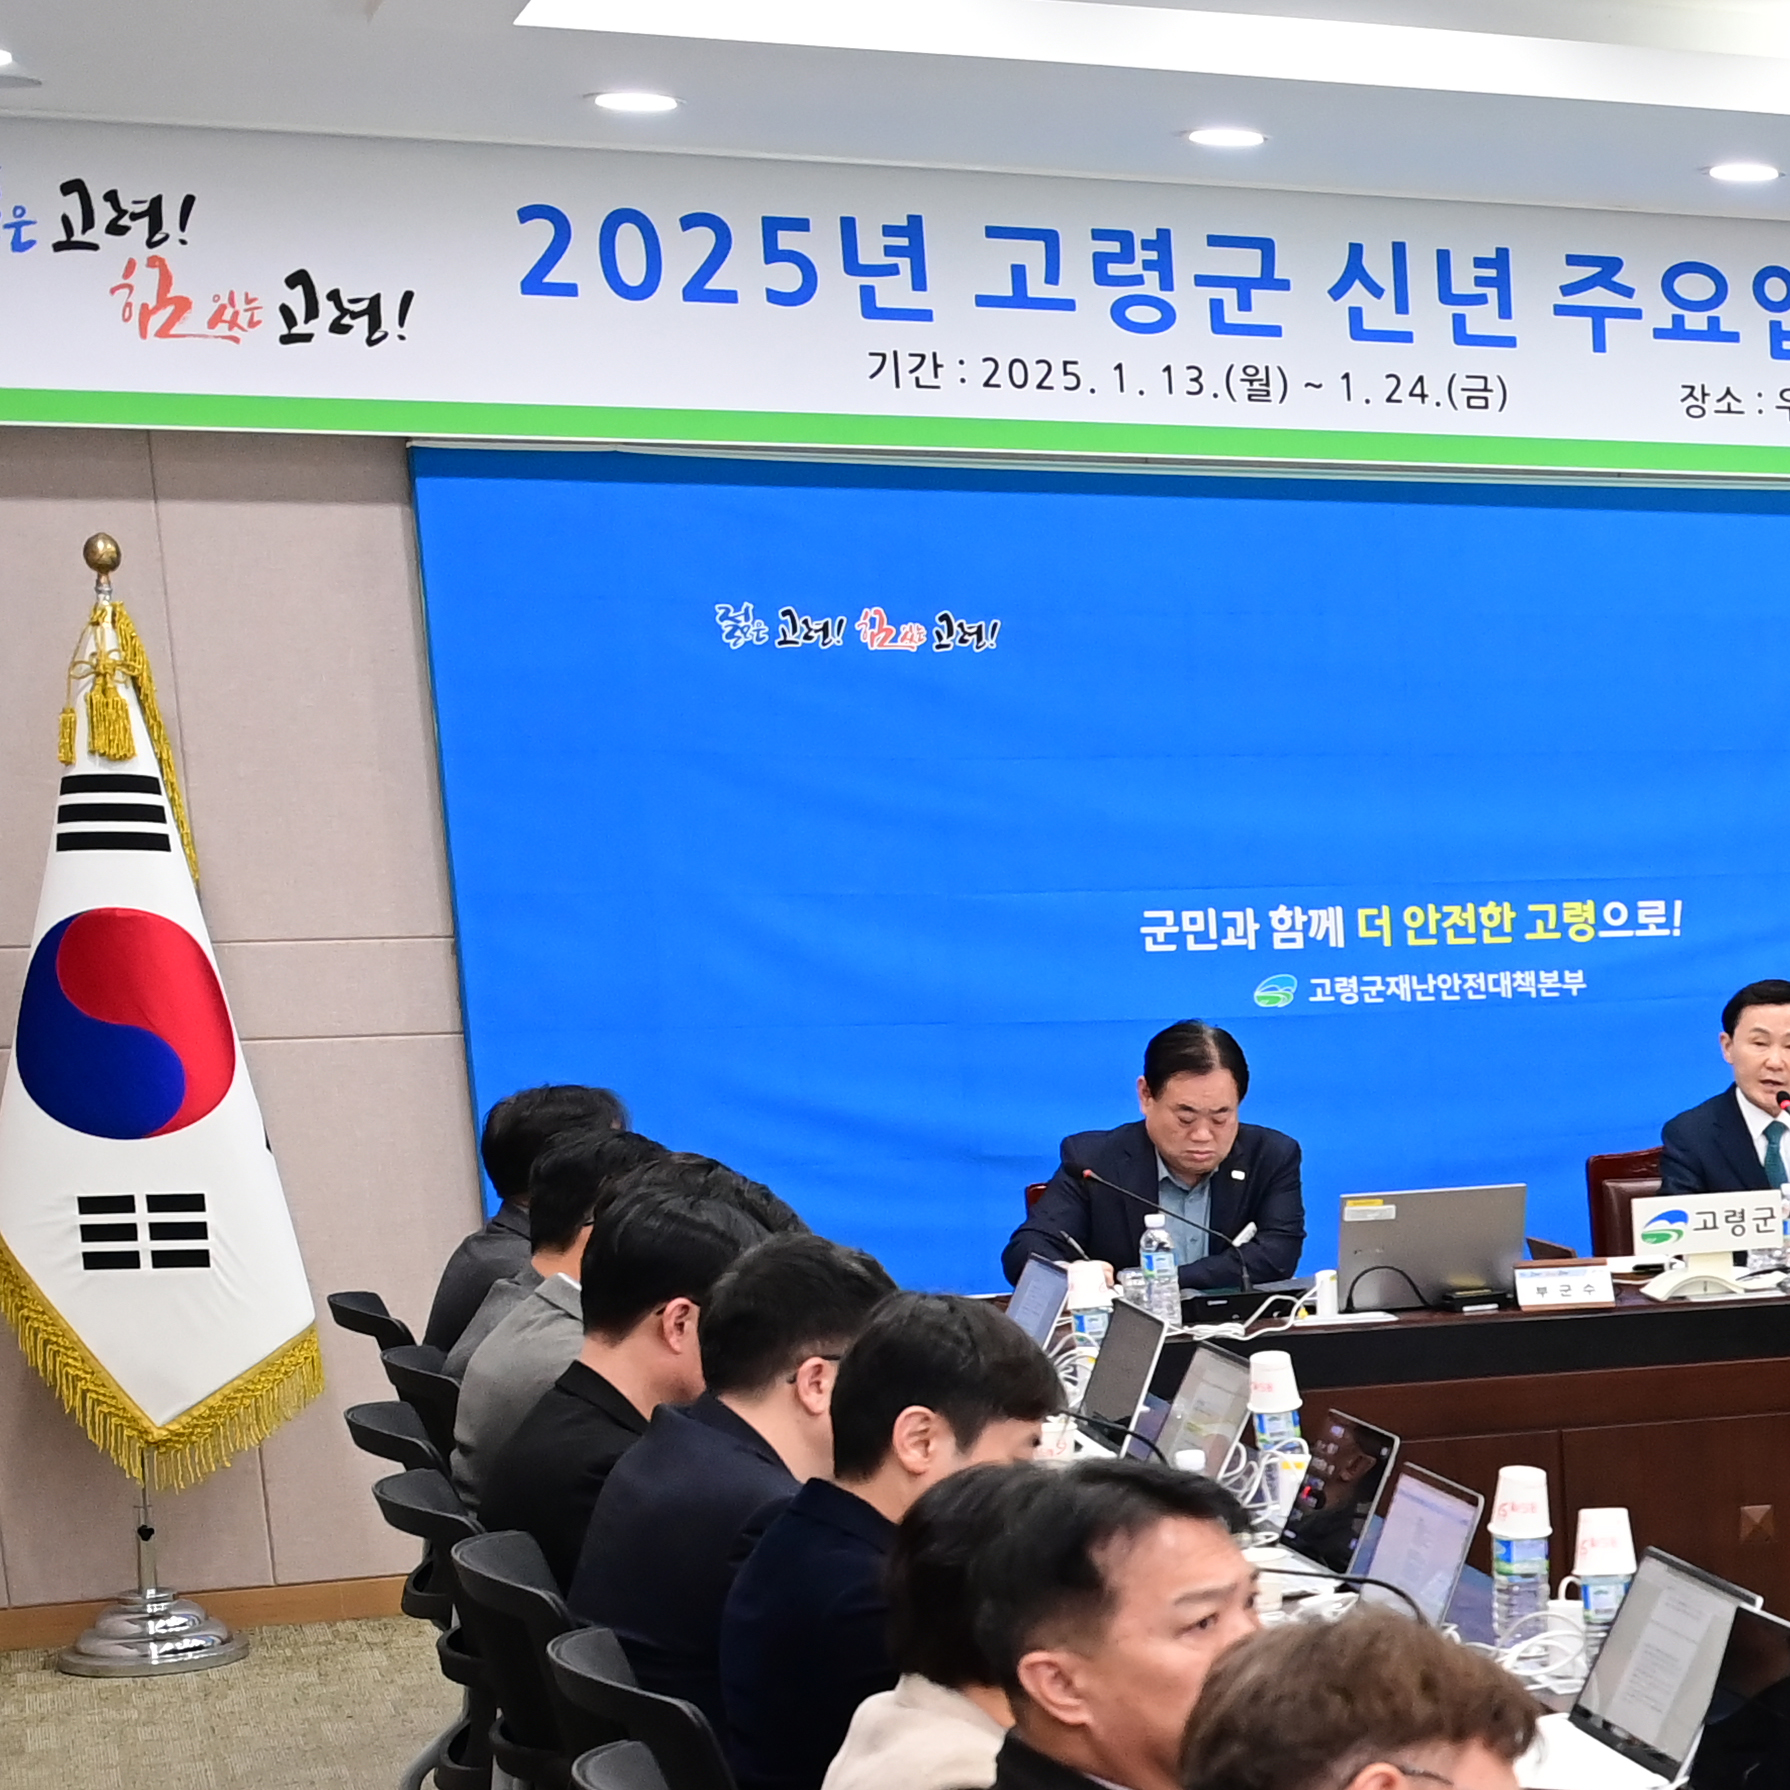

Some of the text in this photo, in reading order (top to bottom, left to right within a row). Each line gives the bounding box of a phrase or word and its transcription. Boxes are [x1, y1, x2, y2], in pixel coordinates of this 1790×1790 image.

[0, 178, 196, 253] 은 고령!
[516, 203, 934, 322] 2025년
[975, 226, 1292, 337] 고령군
[1327, 239, 1518, 351] 신년
[279, 268, 415, 348] 고령!
[776, 606, 847, 649] 고령!
[933, 610, 1001, 652] 고령!
[1139, 898, 1683, 952] 군민과 함께 더 안전한 고령으로!
[1308, 969, 1587, 1004] 고령군재난안전대책본부
[1693, 1207, 1777, 1237] 고령군
